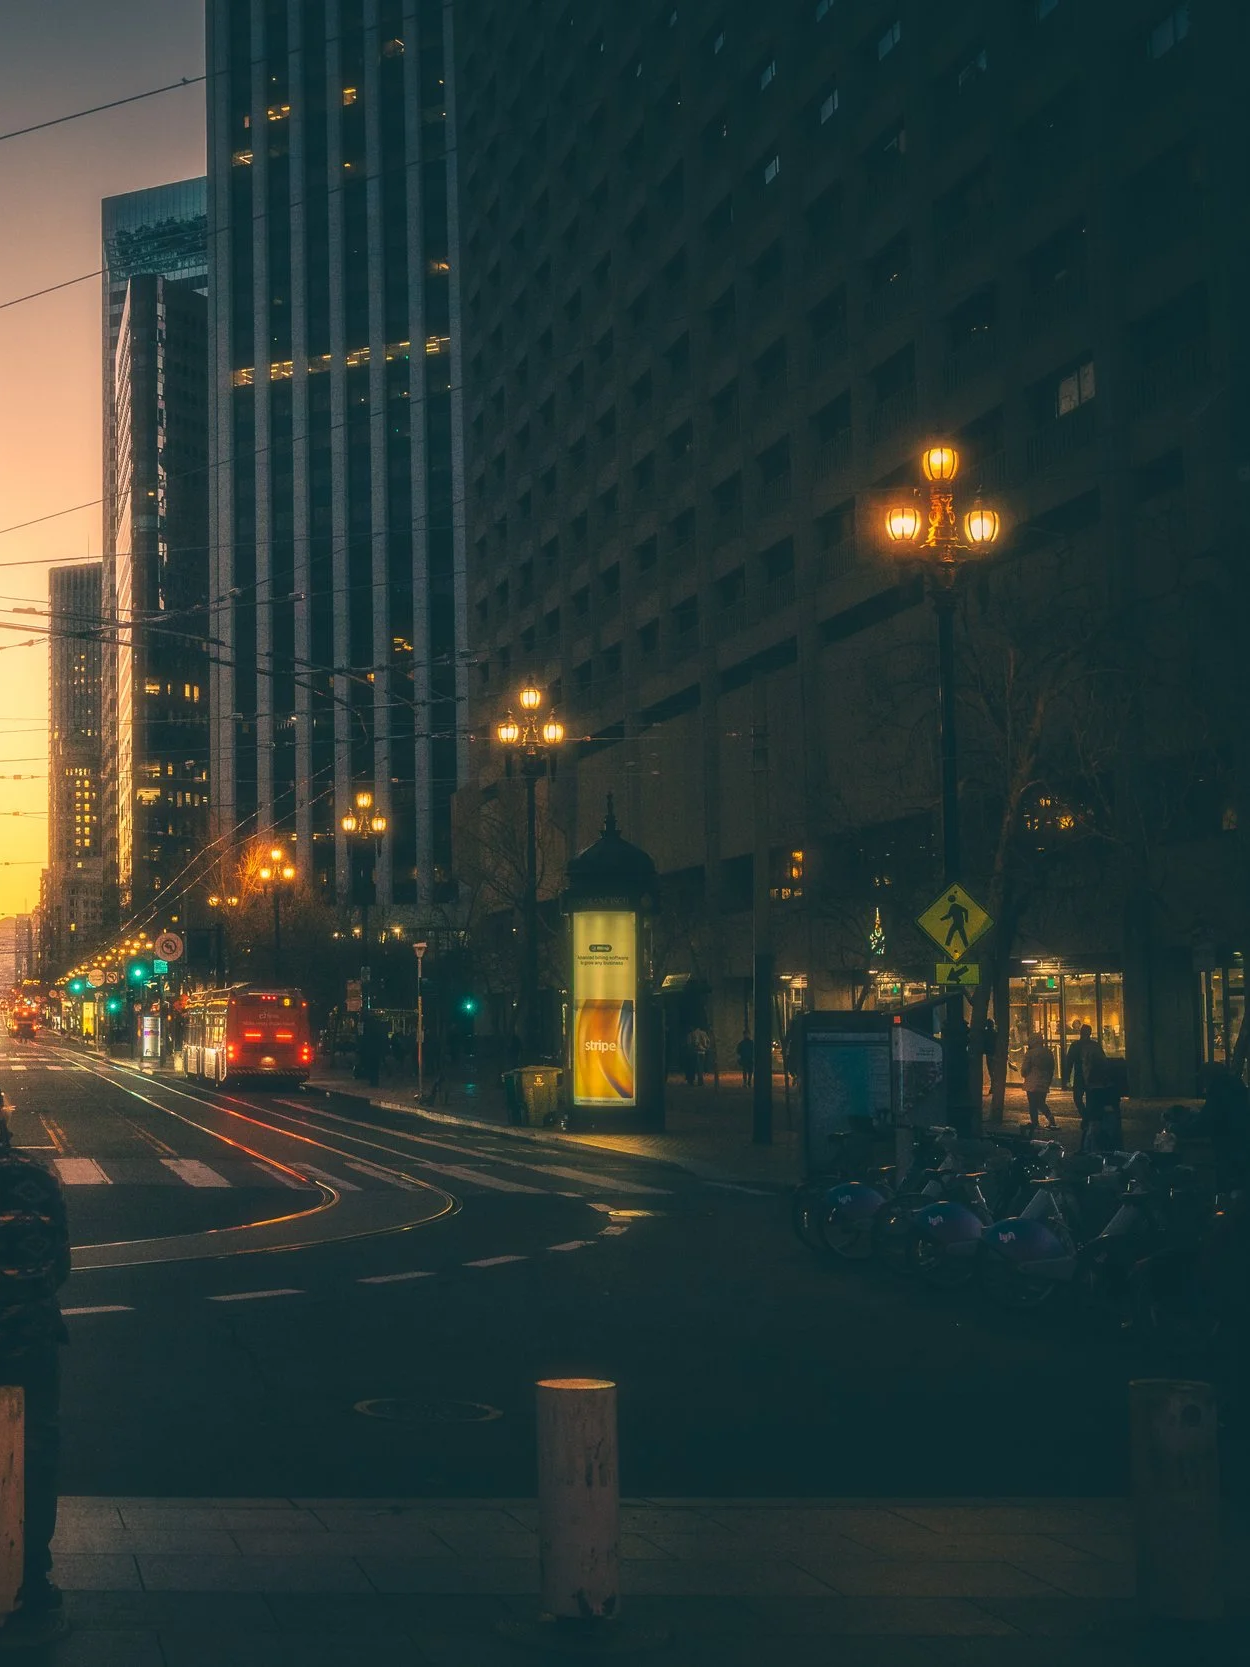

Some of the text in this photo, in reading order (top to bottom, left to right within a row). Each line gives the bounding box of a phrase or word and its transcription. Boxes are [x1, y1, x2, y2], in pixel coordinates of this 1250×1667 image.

[585, 1040, 616, 1053] stripe
[928, 1215, 944, 1226] lyft
[998, 1231, 1016, 1243] lyft
